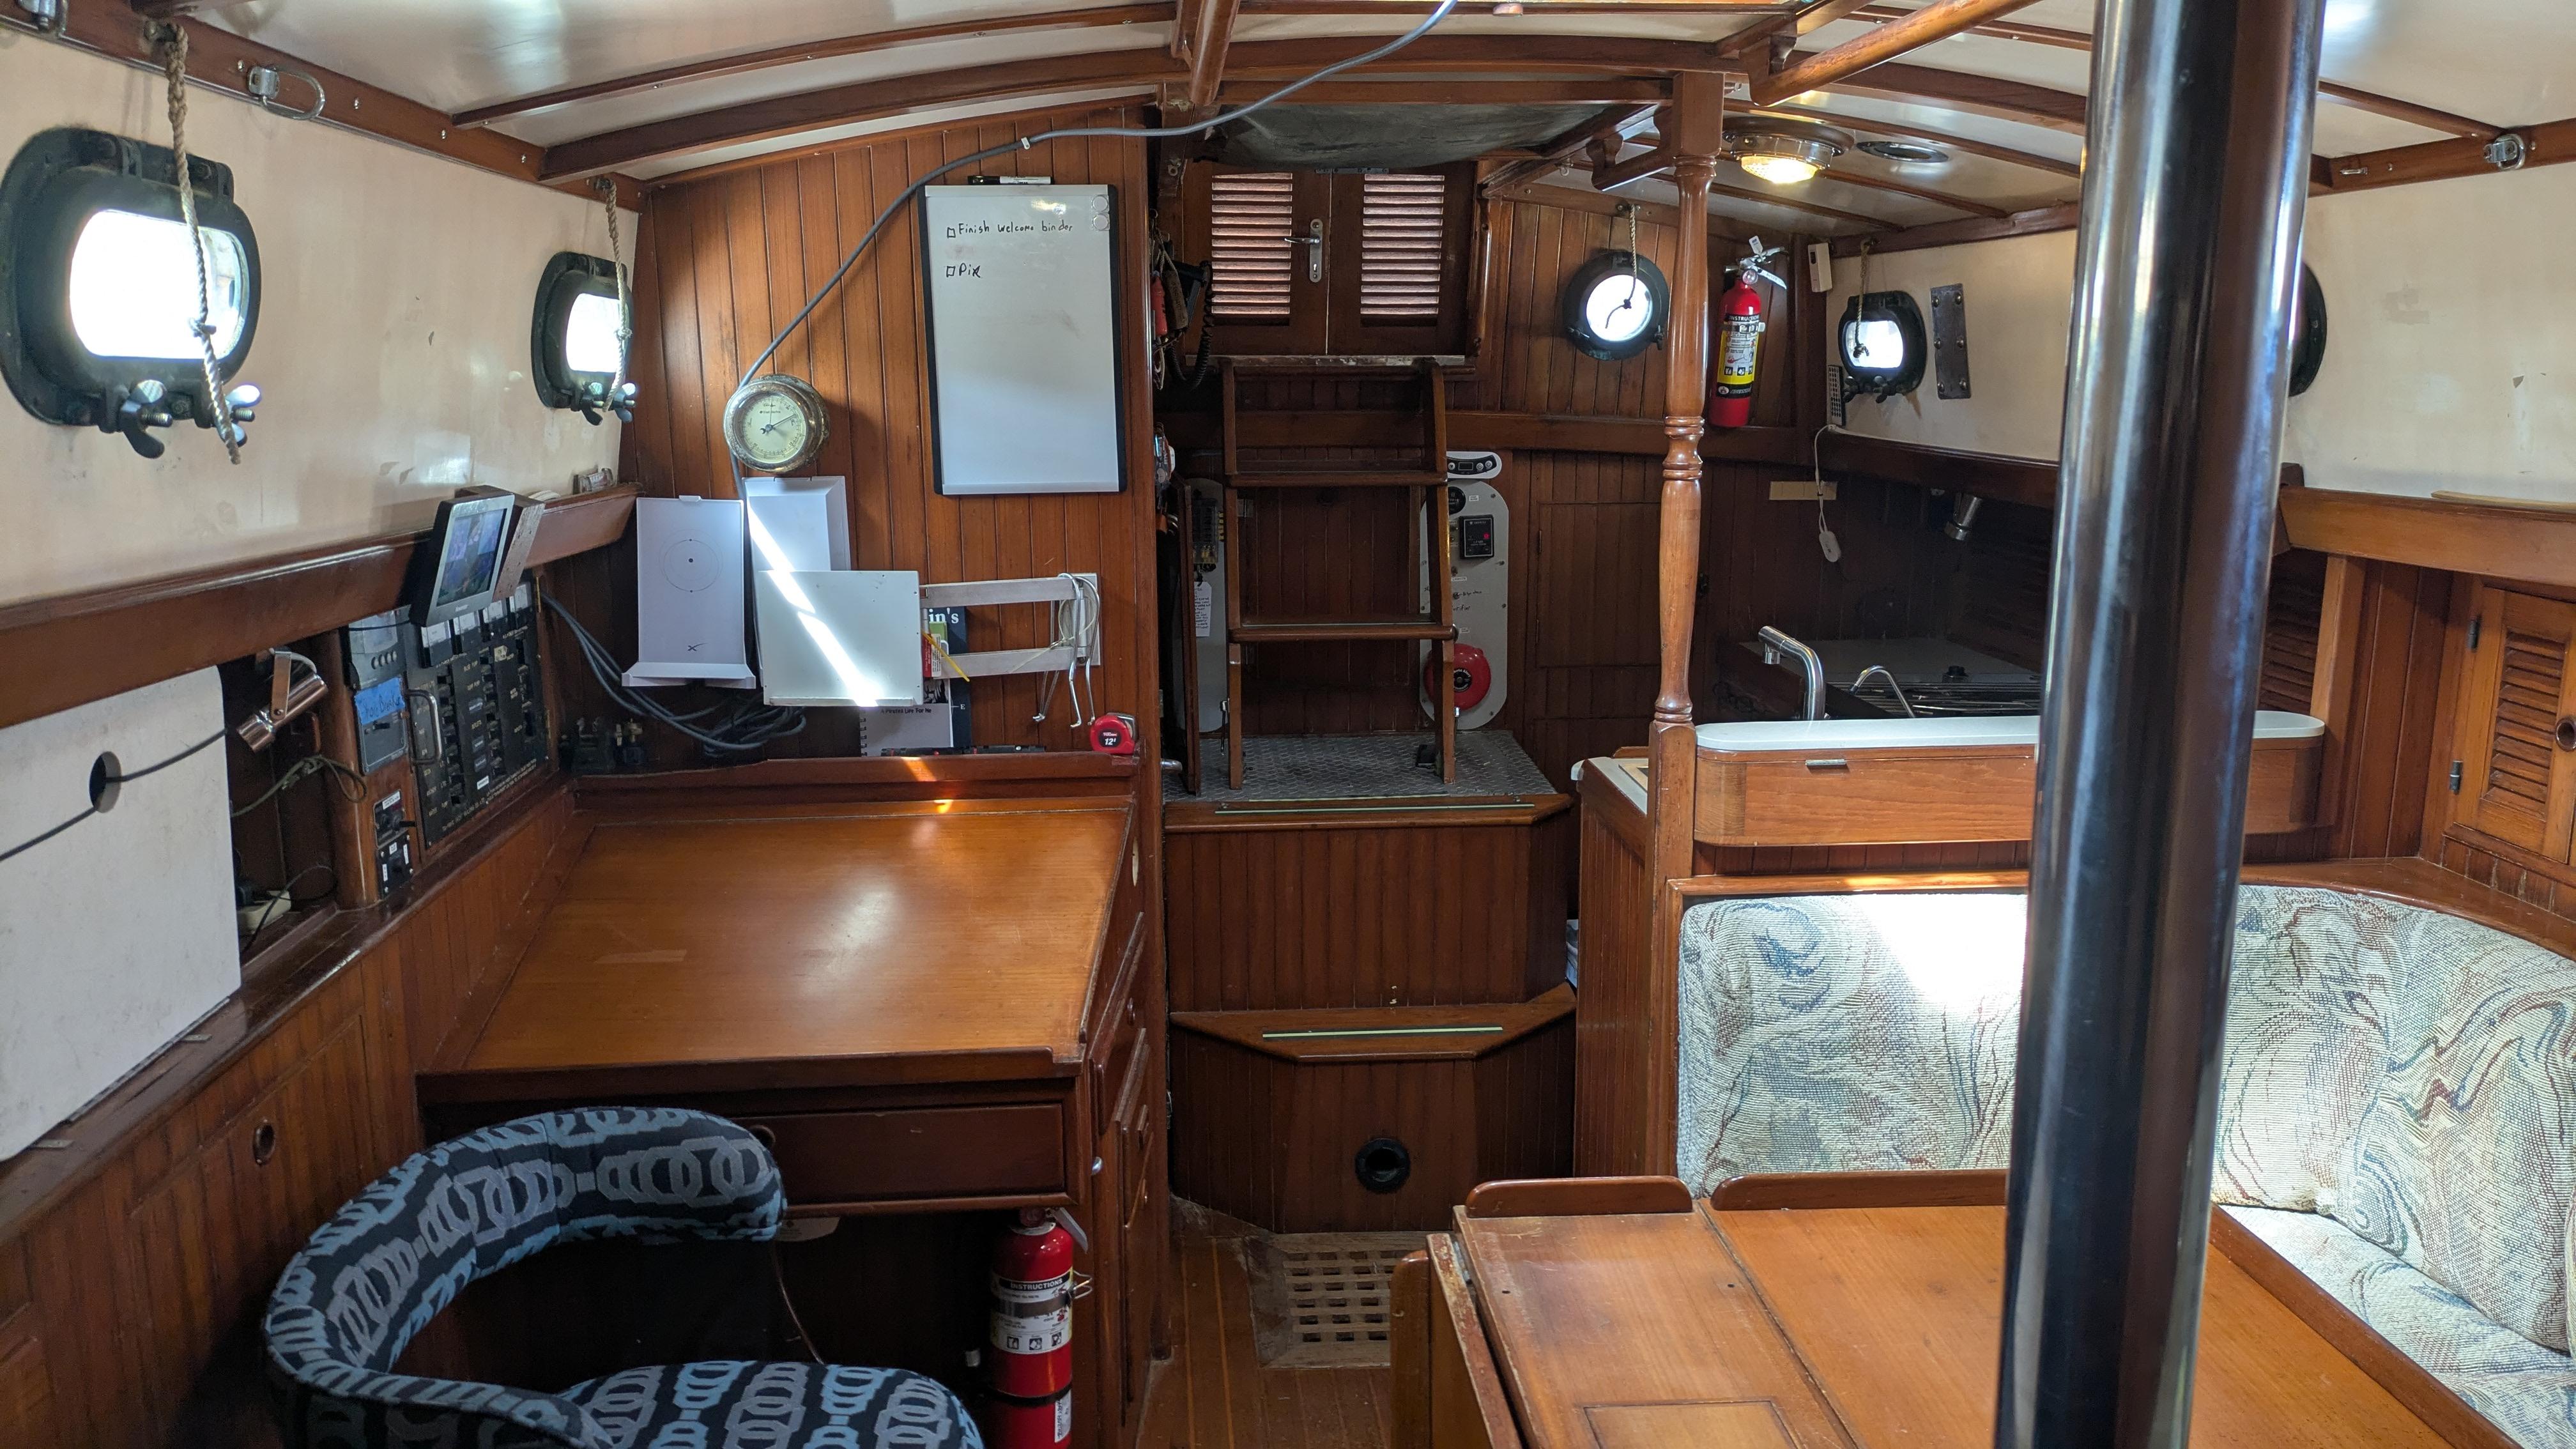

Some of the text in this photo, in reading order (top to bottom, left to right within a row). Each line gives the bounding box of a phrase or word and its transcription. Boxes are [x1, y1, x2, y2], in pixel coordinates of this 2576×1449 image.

[958, 220, 990, 234] Finish
[1041, 219, 1073, 232] binder
[928, 607, 960, 624] in's
